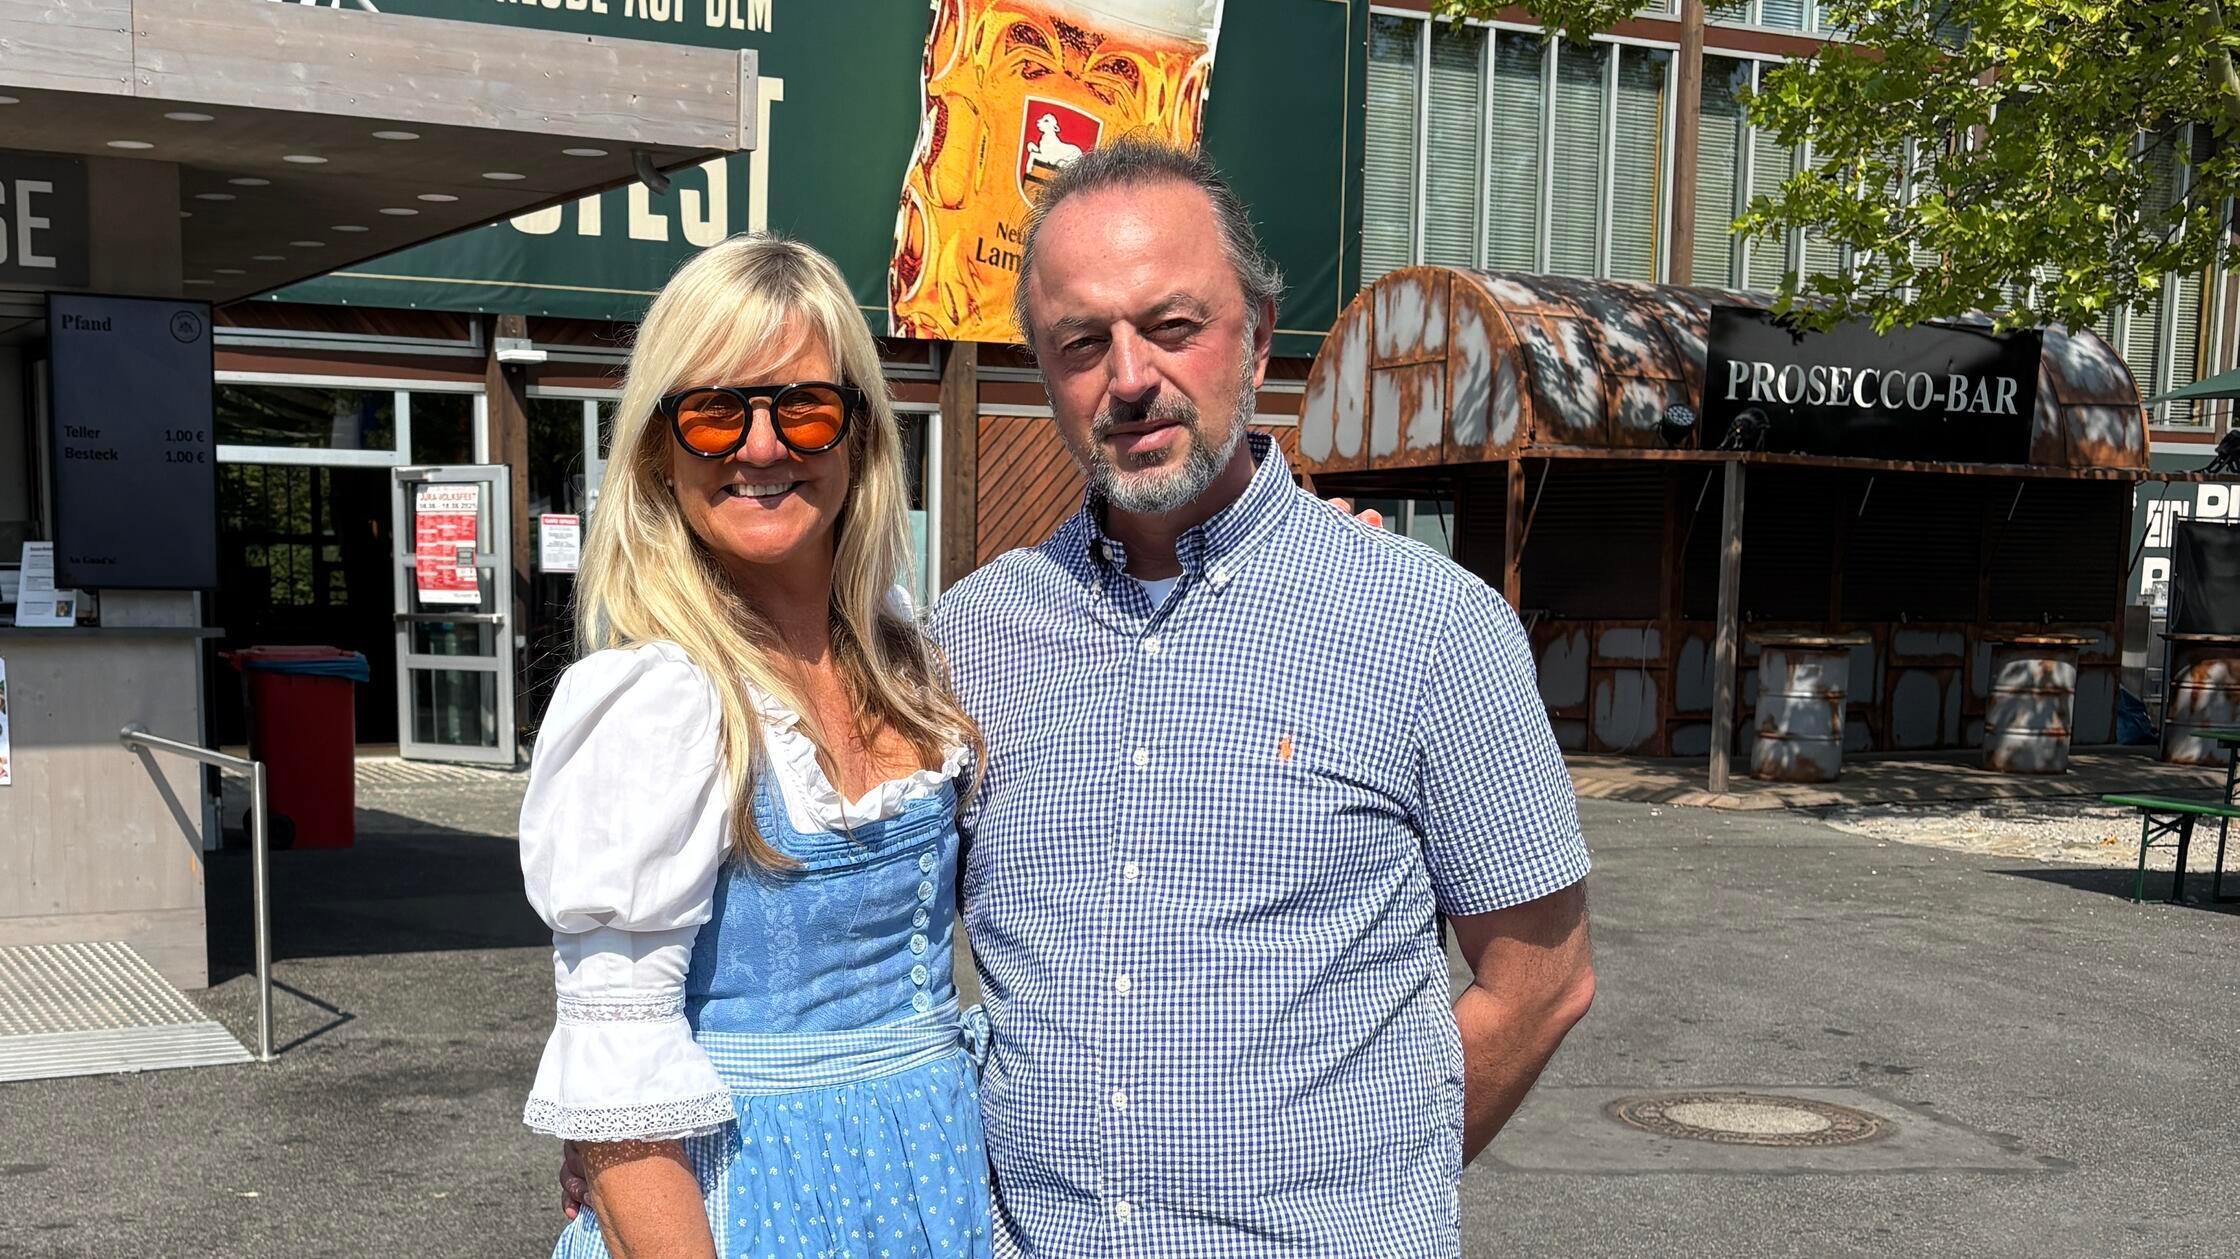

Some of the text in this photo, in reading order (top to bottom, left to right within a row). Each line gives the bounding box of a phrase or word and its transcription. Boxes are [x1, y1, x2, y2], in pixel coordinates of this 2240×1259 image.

[0, 179, 57, 268] E
[61, 314, 112, 332] Pfand
[1724, 359, 2018, 415] PROSECCO-BAR
[64, 425, 205, 443] Teller 1,00 €
[64, 447, 206, 464] Besteck 1,00 €
